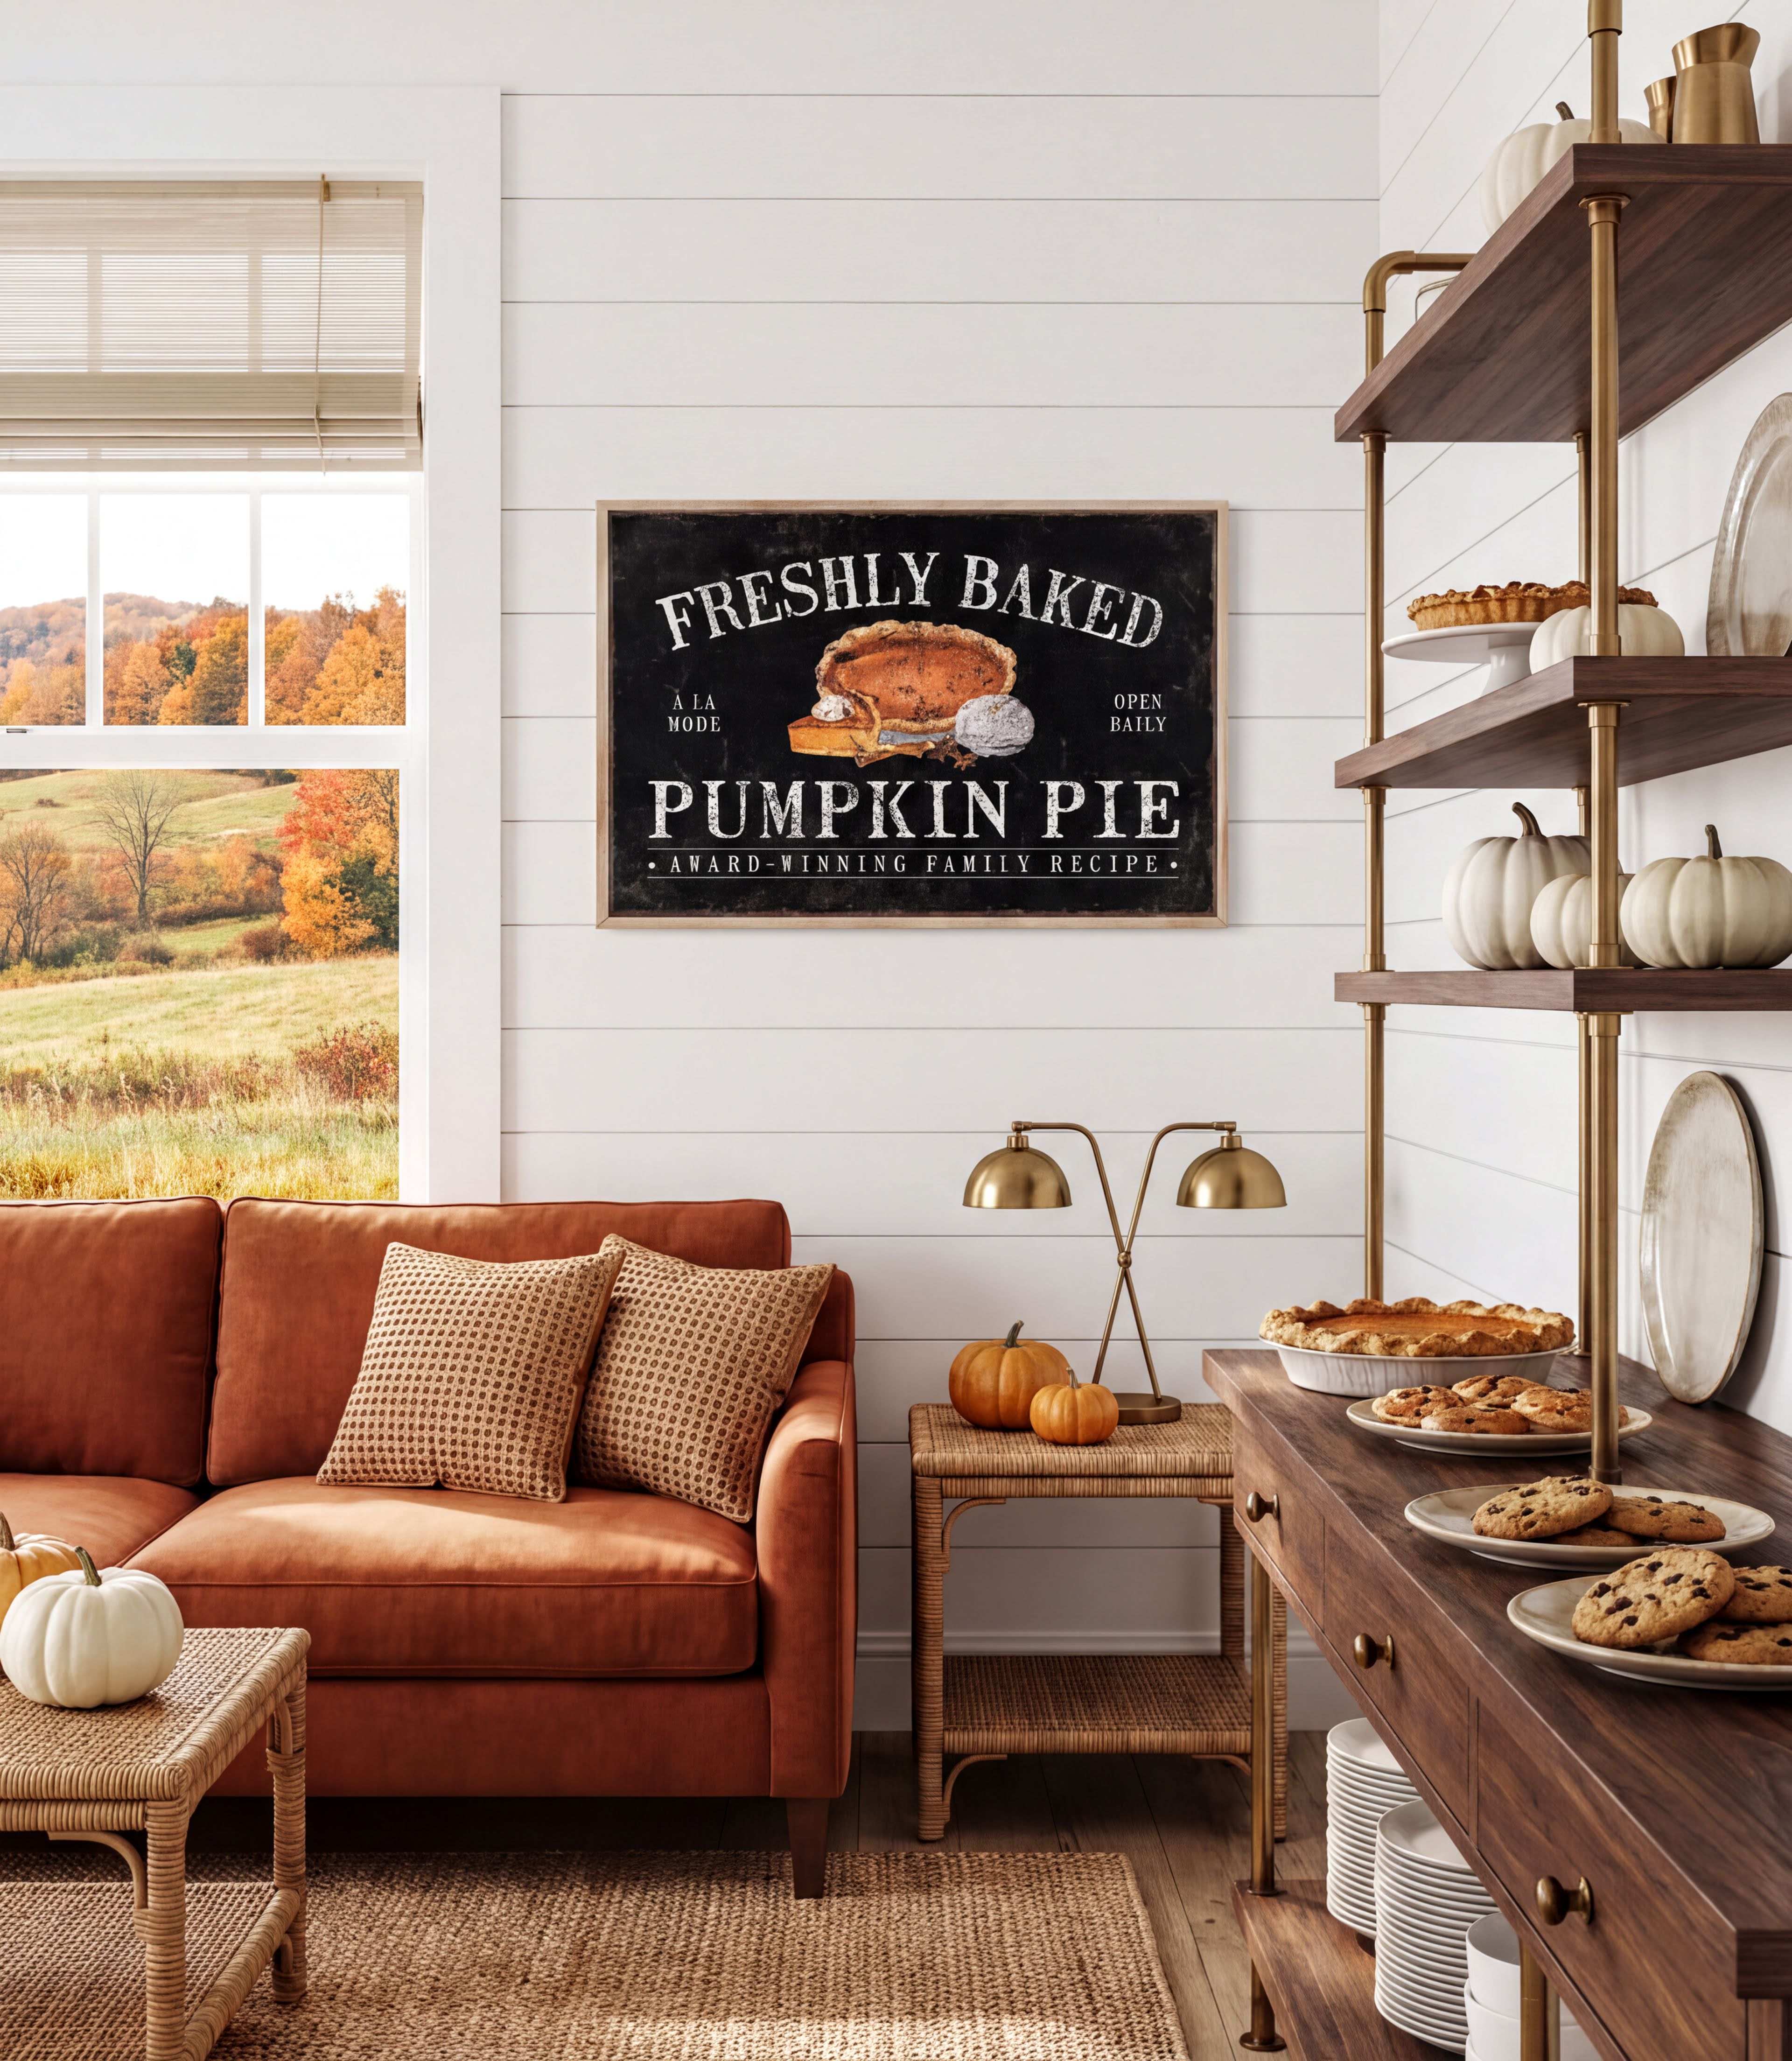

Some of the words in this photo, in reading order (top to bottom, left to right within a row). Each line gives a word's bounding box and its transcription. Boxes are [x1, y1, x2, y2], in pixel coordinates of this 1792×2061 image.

[655, 552, 940, 651] FRESHLY
[958, 554, 1163, 648] BAKED
[672, 694, 683, 710] A
[693, 694, 715, 710] LA
[1114, 694, 1162, 709] OPEN
[668, 716, 720, 732] MODE
[648, 780, 1009, 839] PUMPKIN
[1040, 780, 1180, 838] PIE
[670, 855, 905, 873] AWARD-WINNING
[926, 855, 1030, 872] FAMILY
[1050, 855, 1157, 872] RECIPE
